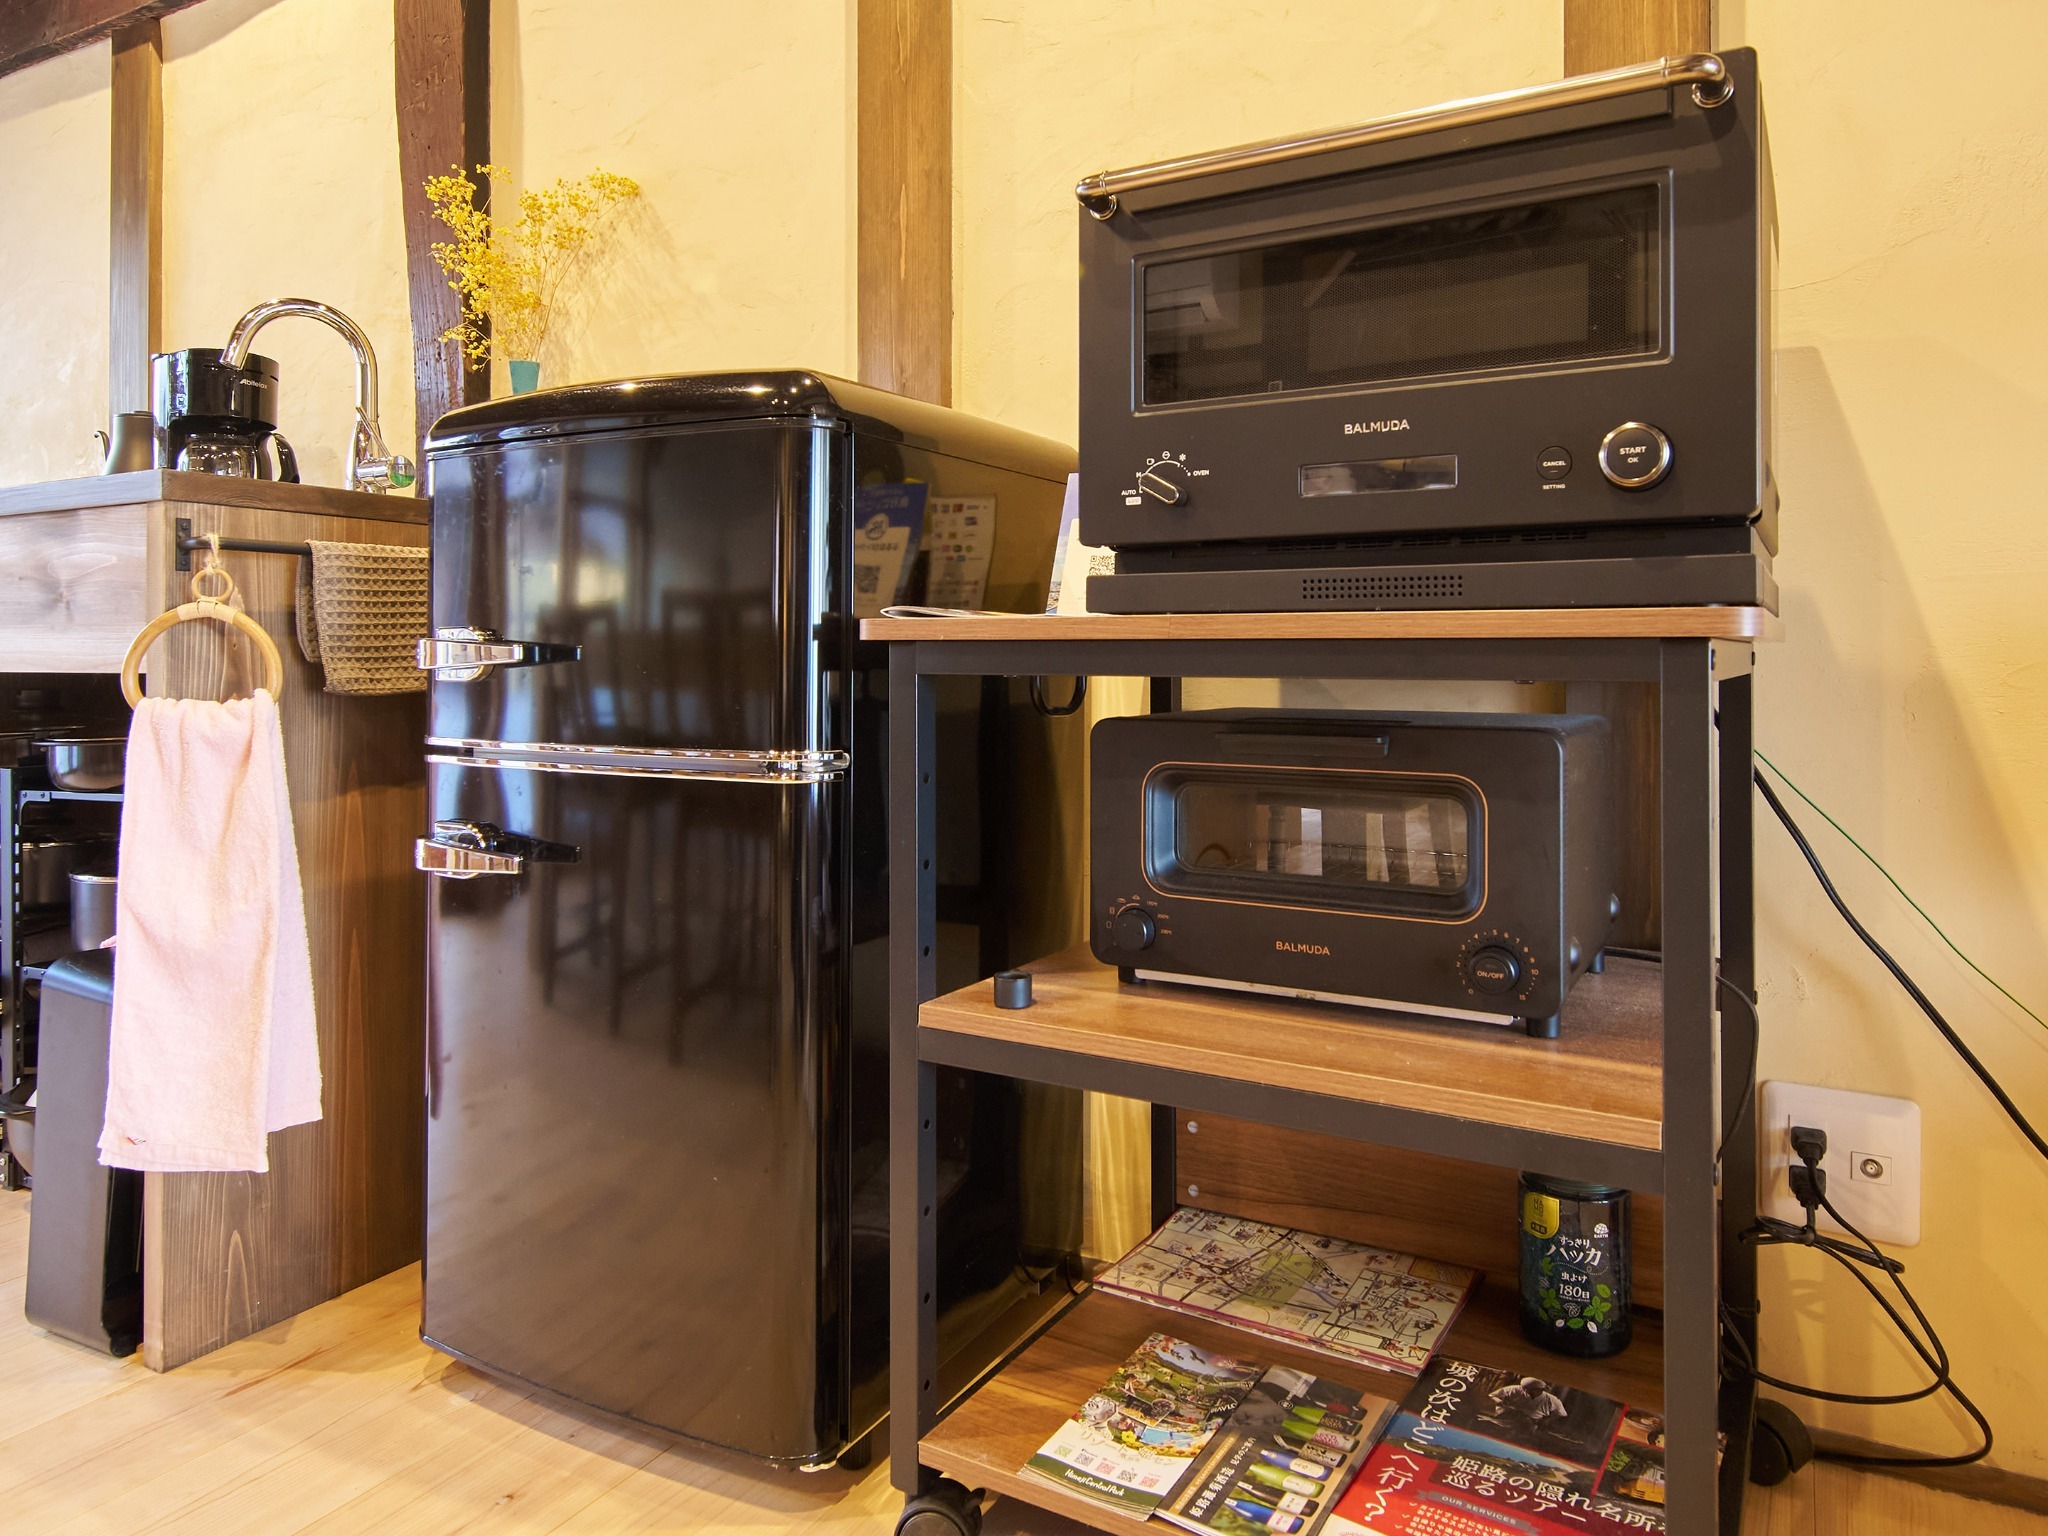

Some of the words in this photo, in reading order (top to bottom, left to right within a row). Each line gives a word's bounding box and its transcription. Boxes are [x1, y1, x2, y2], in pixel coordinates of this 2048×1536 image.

[1344, 419, 1410, 435] BALMUDA
[1619, 446, 1647, 455] START
[1276, 941, 1331, 956] BALMUDA
[1477, 970, 1504, 979] ON/OFF
[1559, 1235, 1590, 1249] すっきり
[1546, 1244, 1602, 1266] ハッカ
[1561, 1271, 1588, 1284] 虫よけ
[1559, 1283, 1590, 1299] 180日
[1442, 1470, 1587, 1522] 巡るツアー
[1441, 1496, 1463, 1506] OUR
[1466, 1504, 1516, 1525] SERVICES
